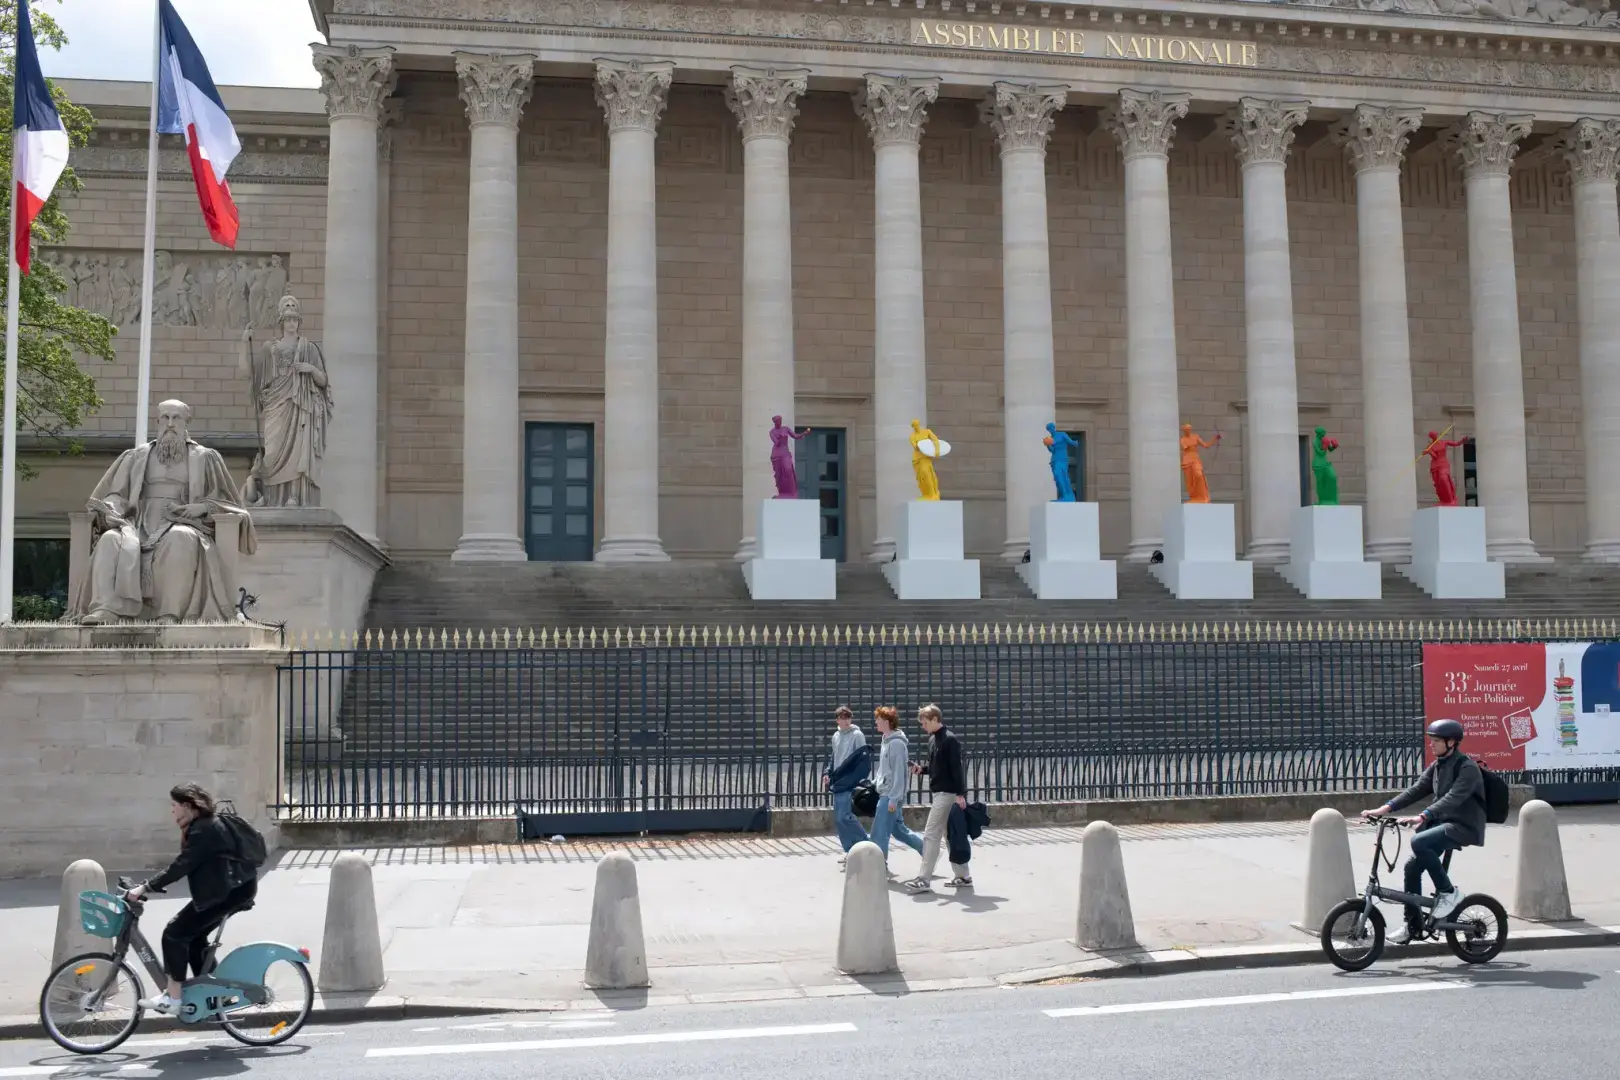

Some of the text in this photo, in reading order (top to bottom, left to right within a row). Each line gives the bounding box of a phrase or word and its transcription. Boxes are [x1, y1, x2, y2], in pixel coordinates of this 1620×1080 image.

[913, 22, 1257, 67] ASSEMBLÉE NATIONALE
[1474, 663, 1528, 672] Samedi 27 avril
[1473, 679, 1517, 692] Journée
[1444, 693, 1524, 706] du Livre Politique
